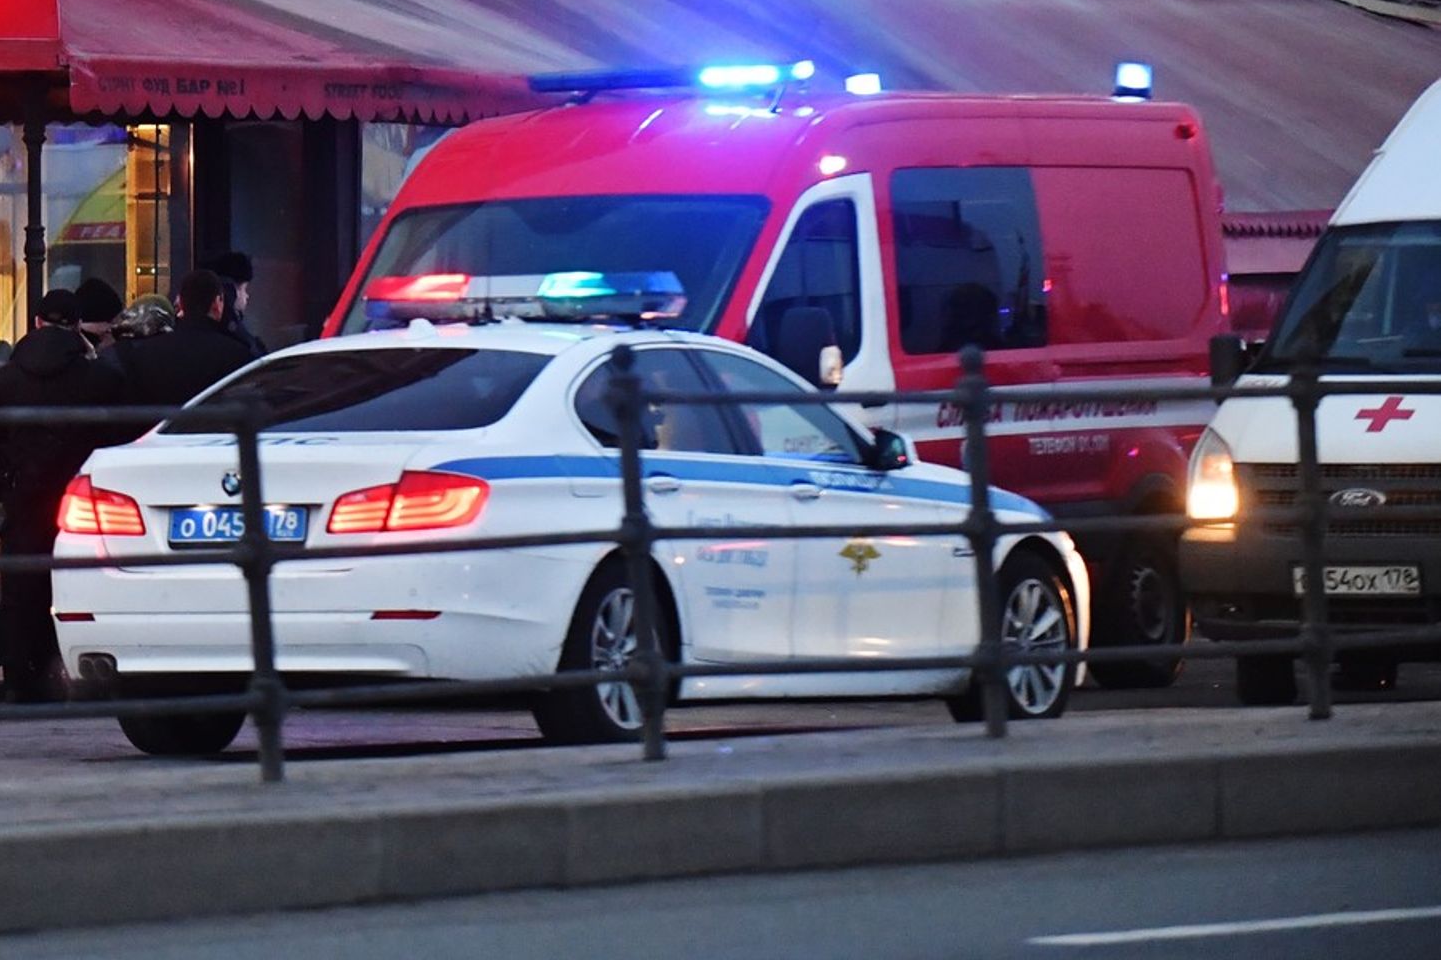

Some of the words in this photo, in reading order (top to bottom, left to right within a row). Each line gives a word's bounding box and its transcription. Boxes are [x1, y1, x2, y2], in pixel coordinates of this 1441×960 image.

[141, 78, 170, 95] ФУД
[176, 78, 211, 94] БАР
[273, 511, 297, 530] 78
